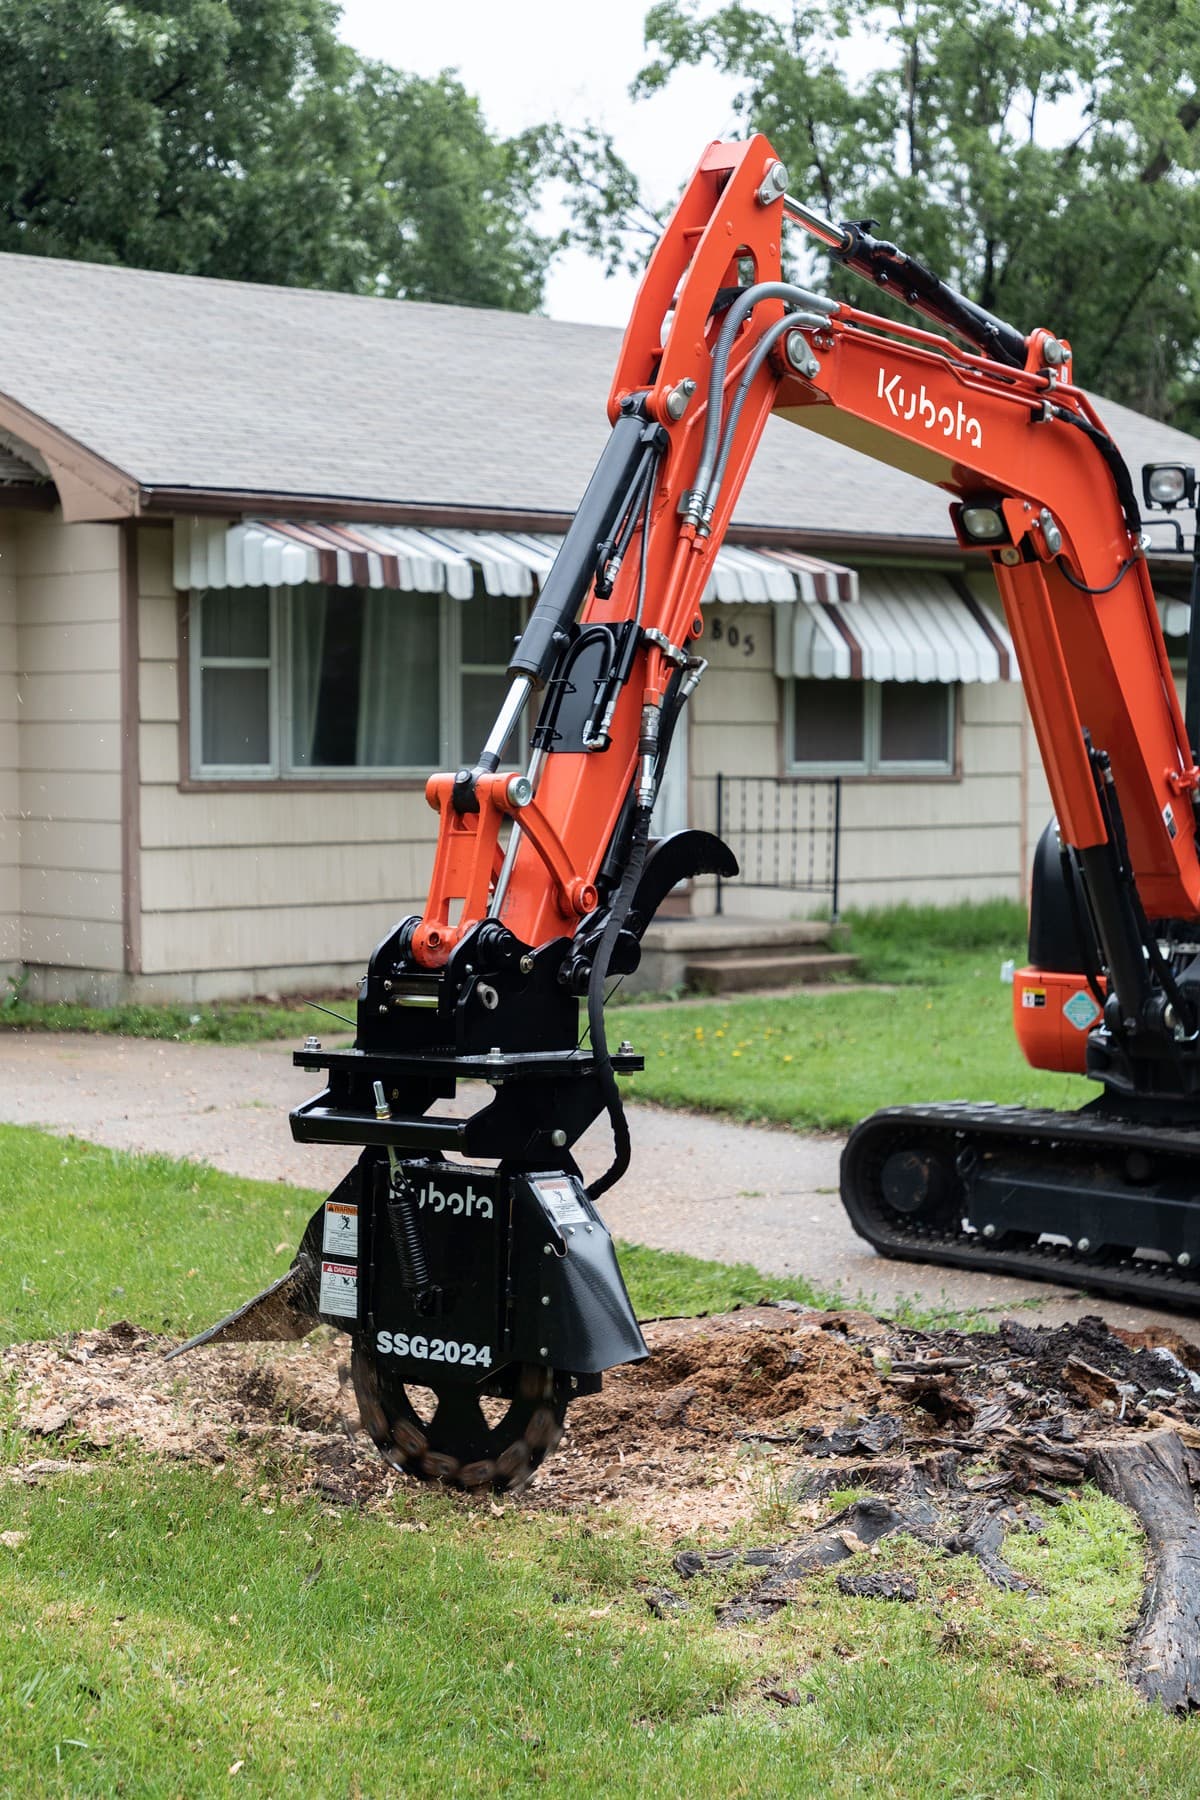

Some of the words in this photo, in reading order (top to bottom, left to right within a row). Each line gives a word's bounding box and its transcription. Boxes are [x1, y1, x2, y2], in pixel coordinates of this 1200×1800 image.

[877, 368, 982, 448] Kubota
[333, 1265, 357, 1276] DANGER
[376, 1330, 492, 1368] SSG2024
